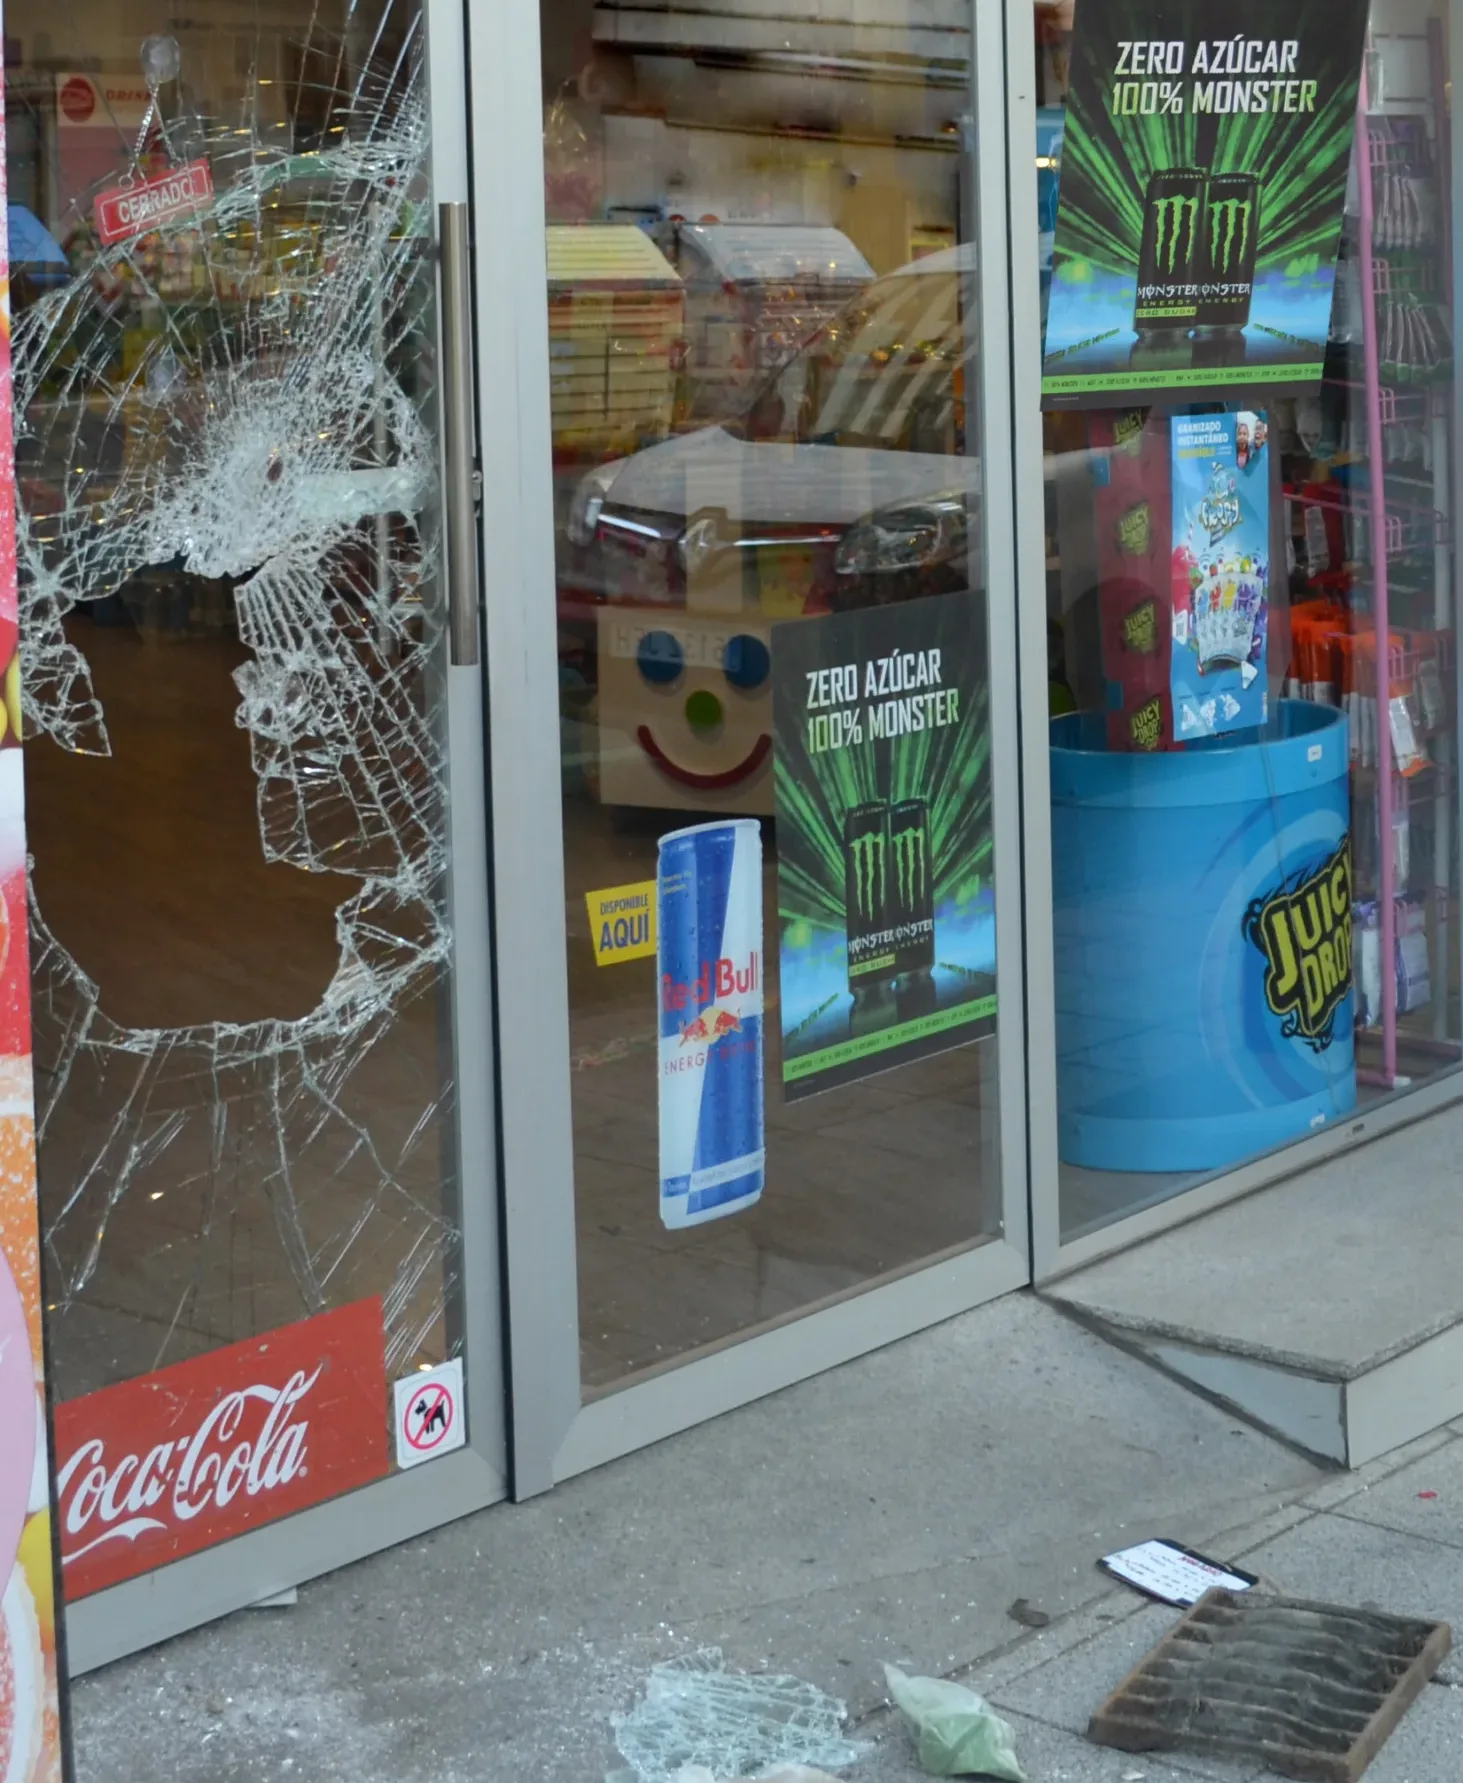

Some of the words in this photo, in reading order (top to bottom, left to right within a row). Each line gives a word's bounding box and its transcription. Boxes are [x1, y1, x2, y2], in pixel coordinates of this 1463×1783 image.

[1114, 41, 1184, 75] ZERO
[1191, 33, 1298, 74] AZÚCAR
[1112, 81, 1183, 116] 100%
[1192, 80, 1317, 114] MONSTER
[1137, 284, 1198, 299] MONSTER
[1201, 282, 1250, 297] ONSTER
[806, 664, 858, 709] ZERO
[864, 648, 941, 698] AZÚCAR
[808, 708, 862, 754] 100%
[868, 688, 959, 741] MONSTER
[1131, 700, 1161, 738] JUICY
[600, 893, 649, 916] DISPONIBLE
[600, 908, 649, 952] AQUÍ
[848, 929, 895, 954] MONSTER
[896, 918, 933, 940] ONSTER
[662, 960, 710, 1013] Red
[715, 951, 758, 998] Bull
[58, 1364, 323, 1540] Coca-Cola
